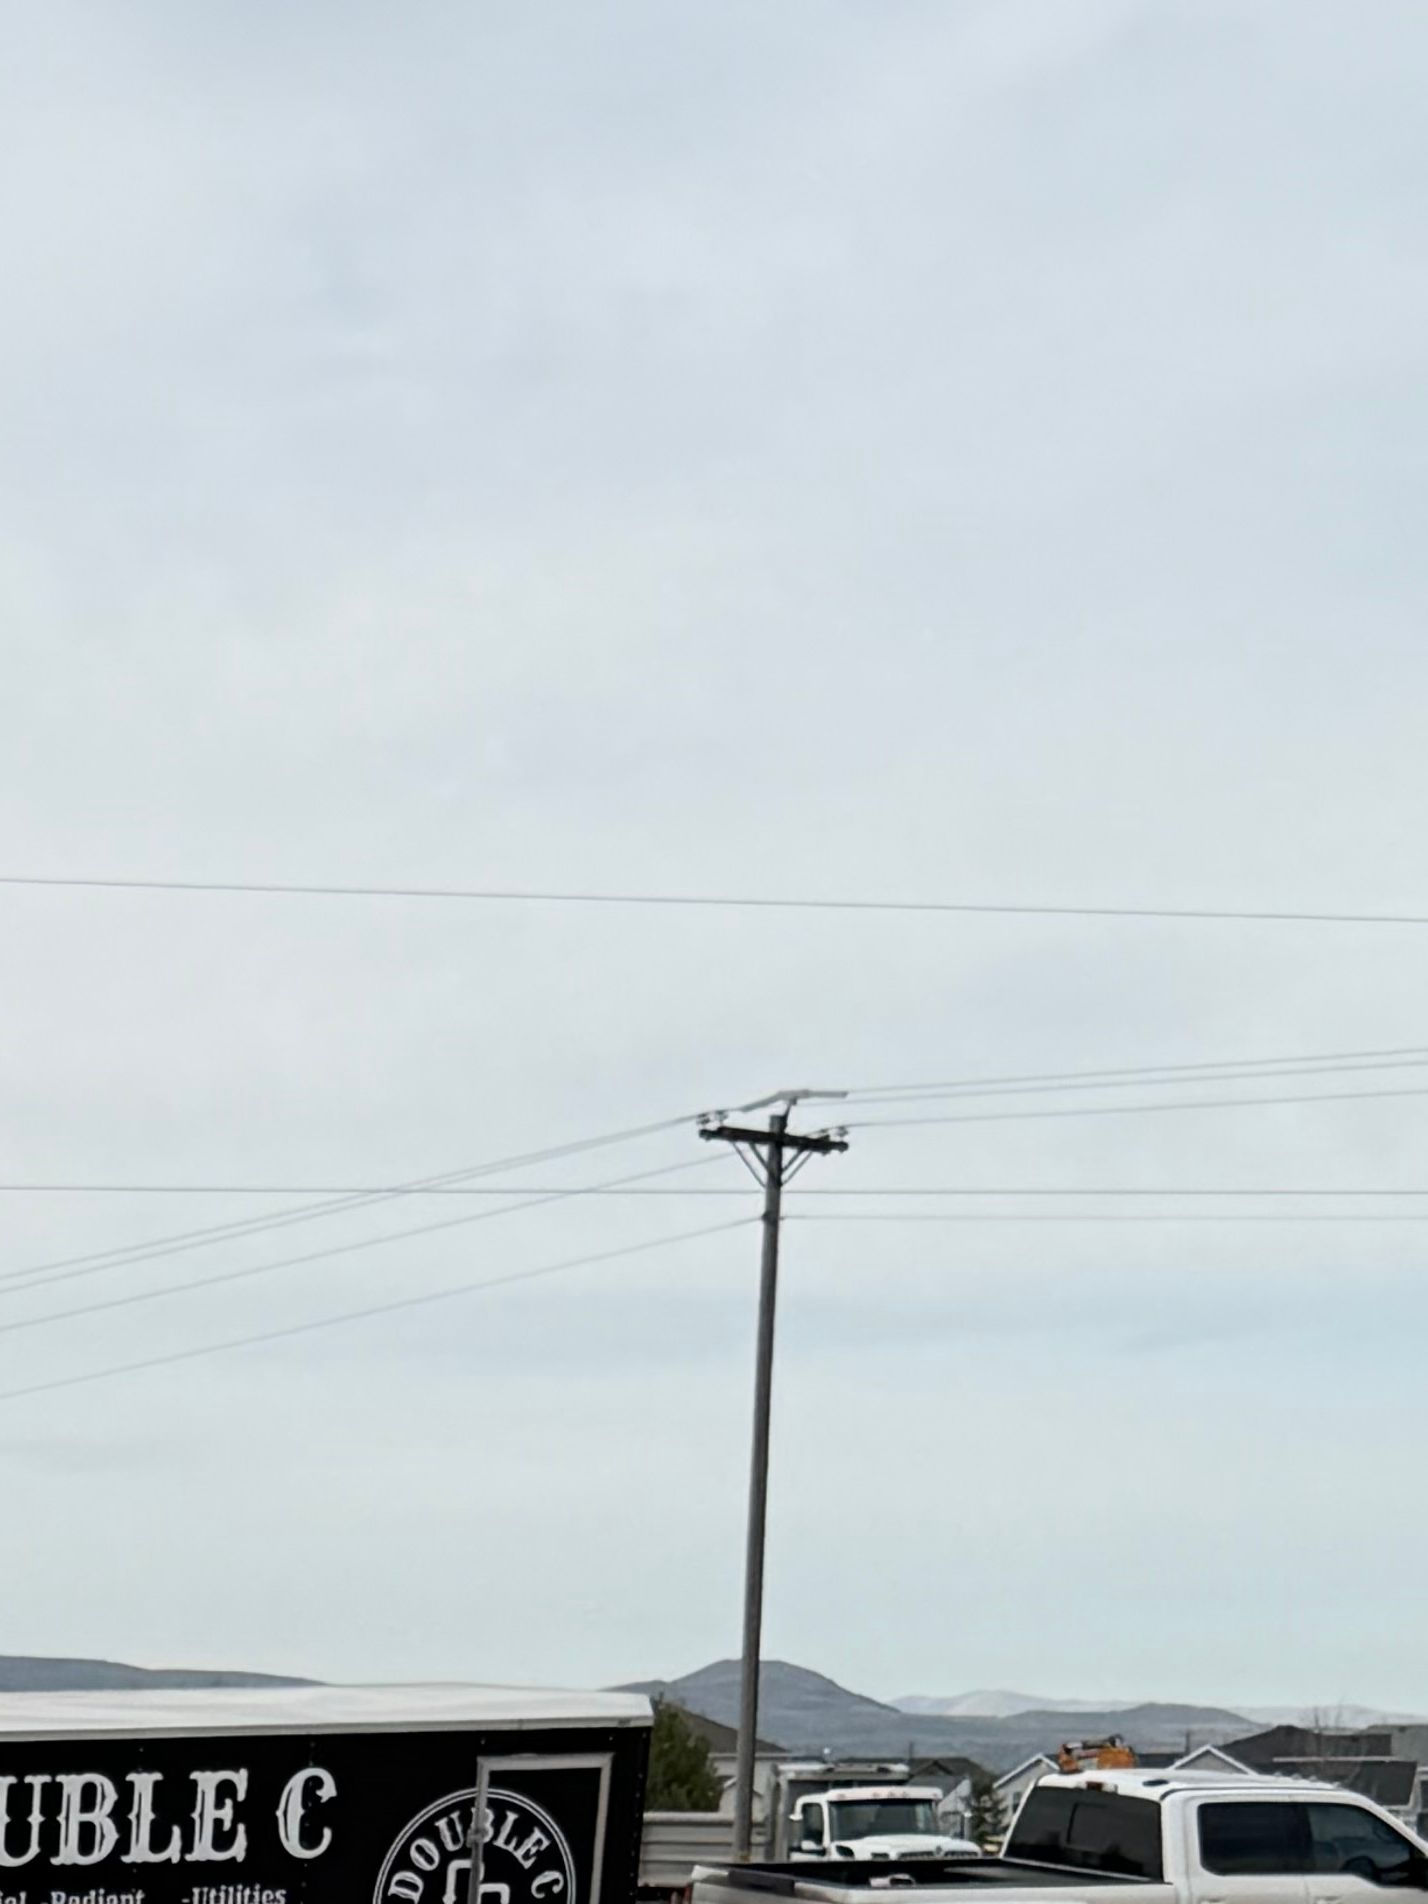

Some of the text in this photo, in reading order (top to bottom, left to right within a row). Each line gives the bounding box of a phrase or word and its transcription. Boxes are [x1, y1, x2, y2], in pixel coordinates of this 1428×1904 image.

[275, 1768, 337, 1859] C
[387, 1807, 564, 1904] DOUBLE C
